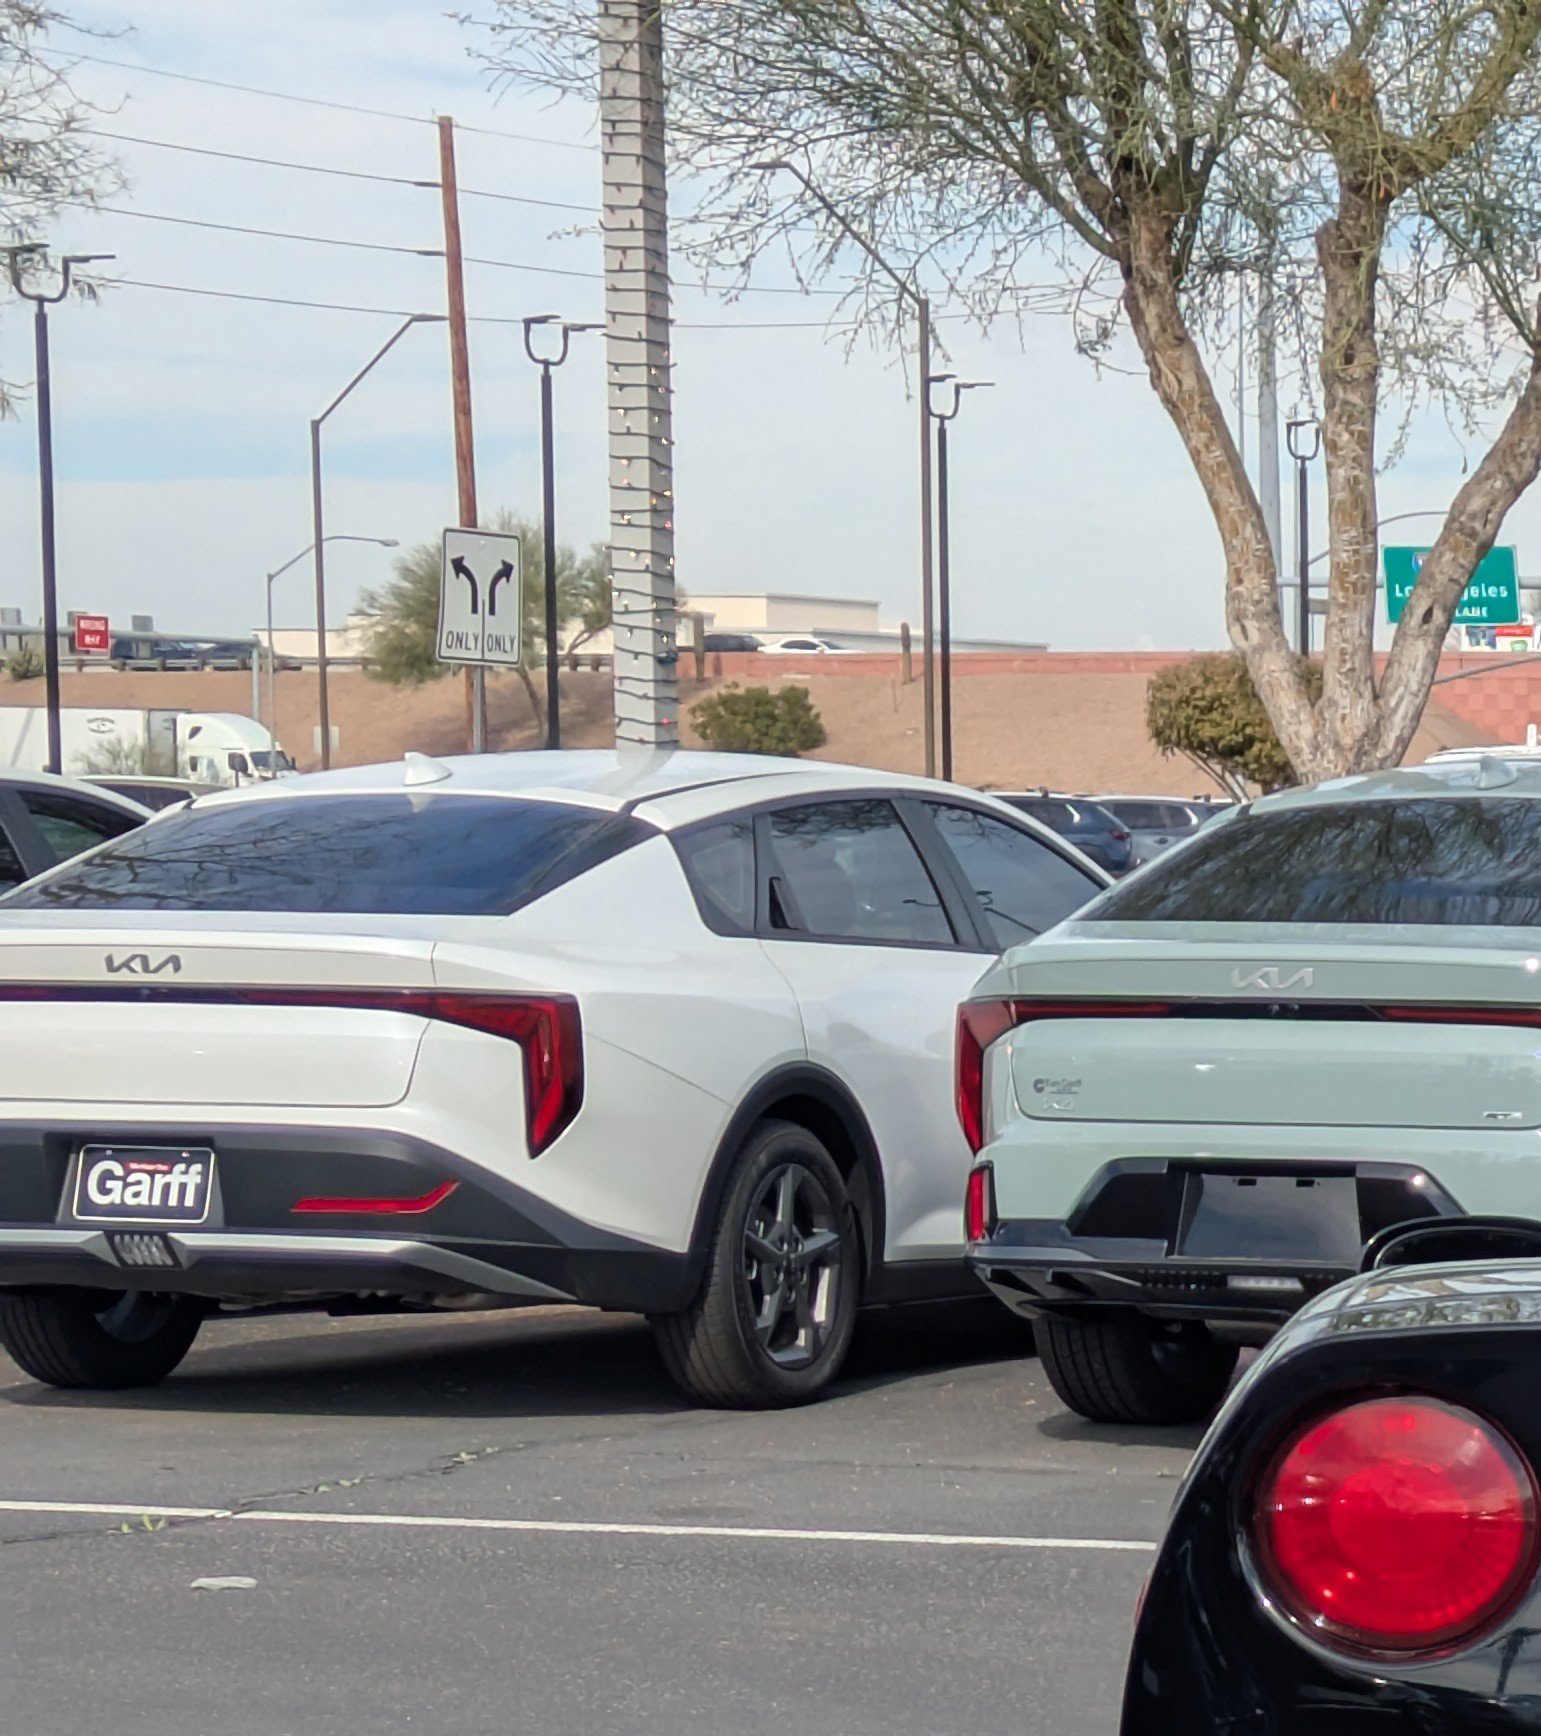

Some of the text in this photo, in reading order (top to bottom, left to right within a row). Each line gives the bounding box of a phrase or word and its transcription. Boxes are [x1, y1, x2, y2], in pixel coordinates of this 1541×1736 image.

[1394, 582, 1508, 601] Lo geles
[445, 630, 480, 651] ONLY
[486, 633, 516, 654] ONLY
[104, 953, 182, 974] KIA
[1231, 967, 1314, 990] KIA
[87, 1160, 203, 1208] Garff
